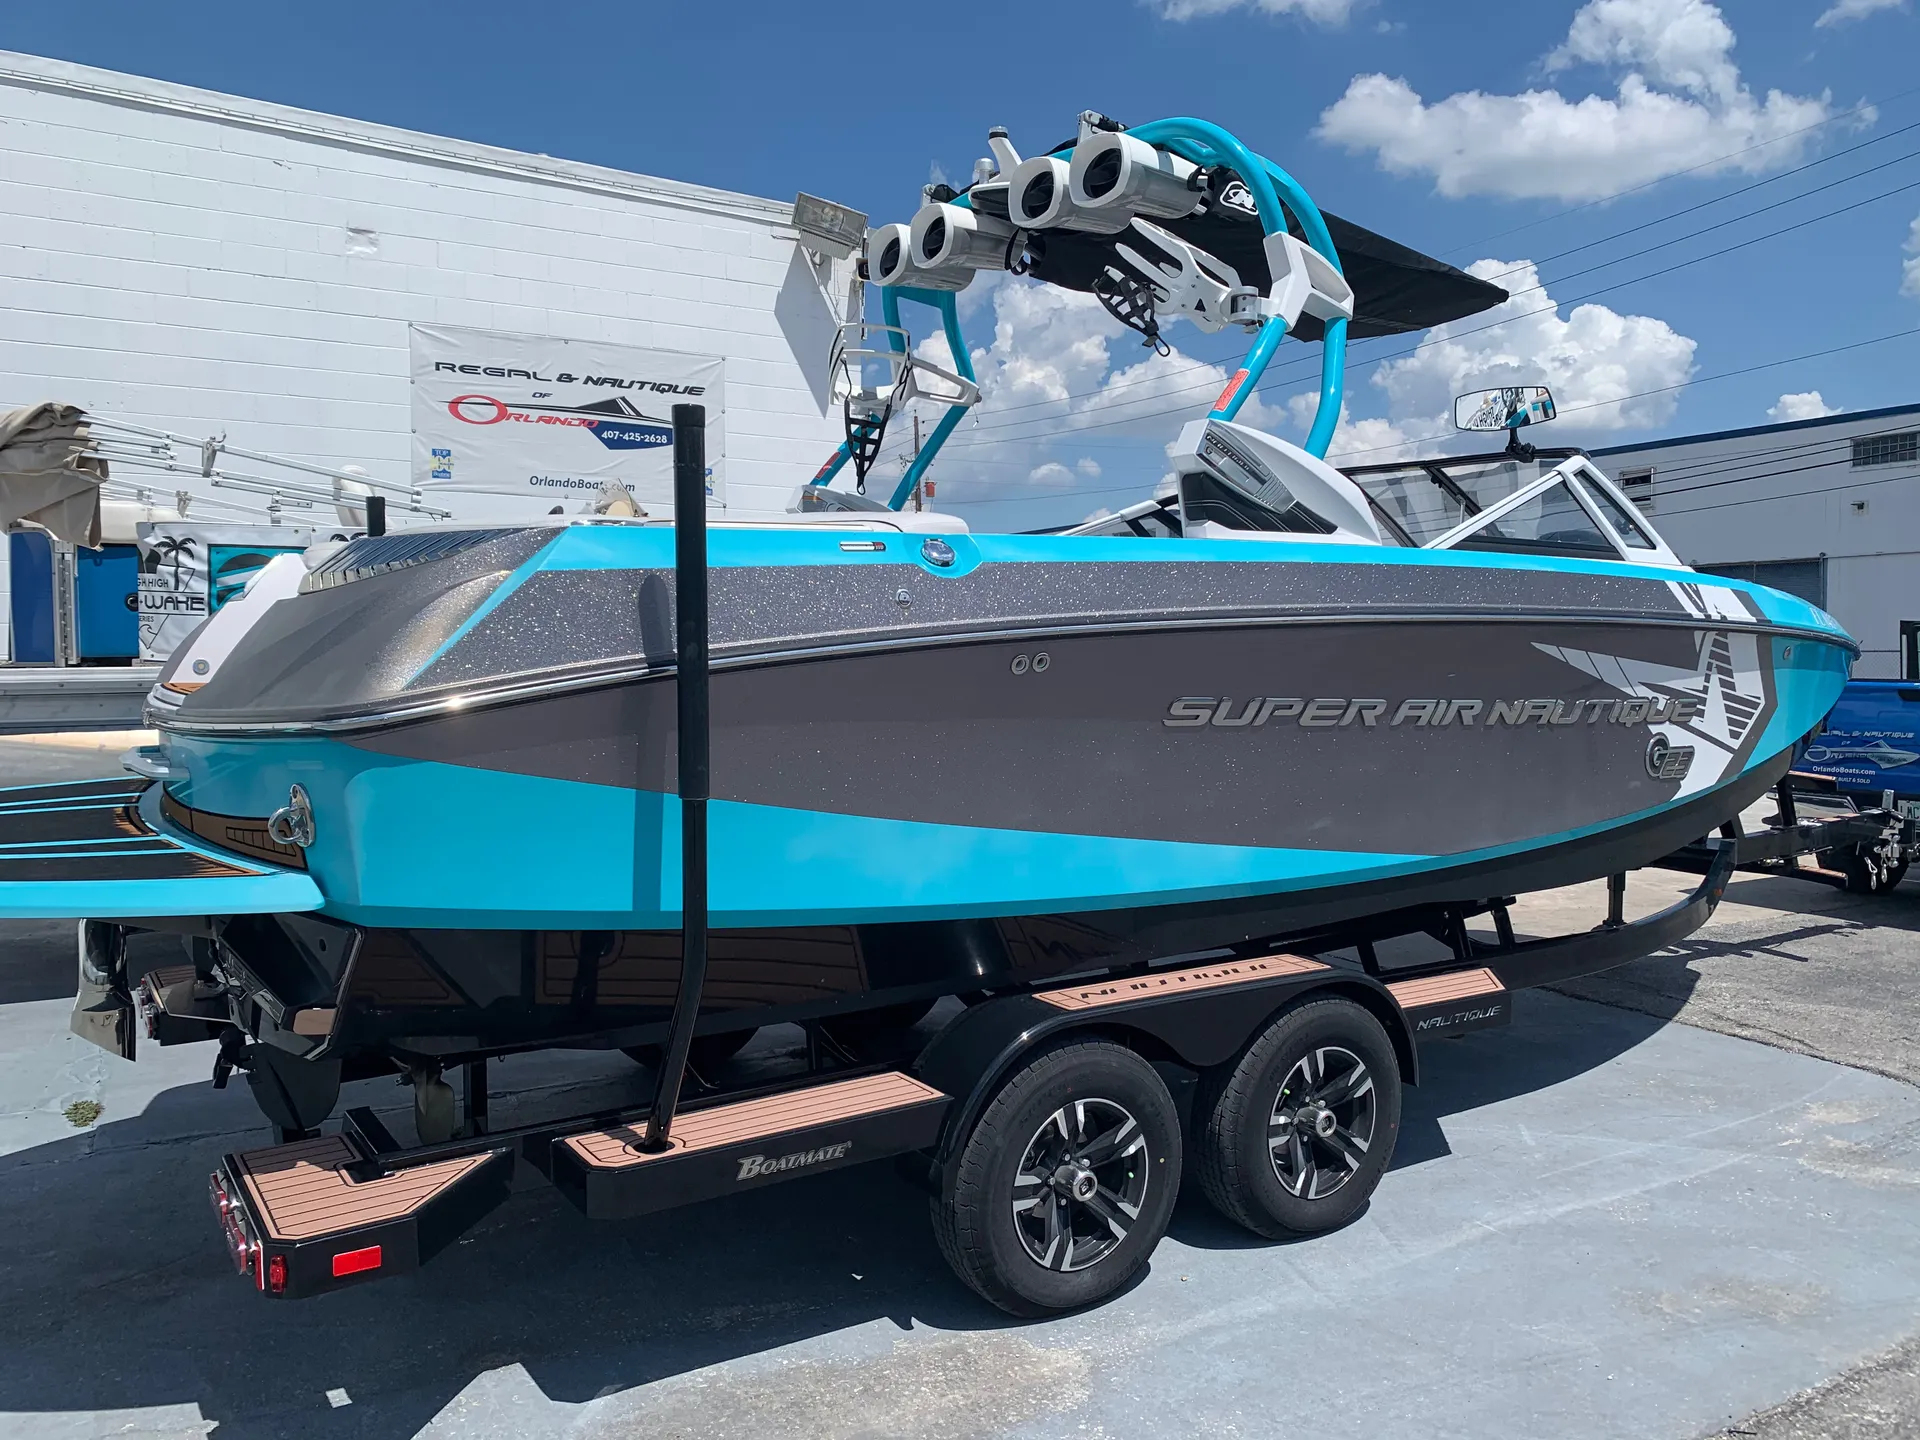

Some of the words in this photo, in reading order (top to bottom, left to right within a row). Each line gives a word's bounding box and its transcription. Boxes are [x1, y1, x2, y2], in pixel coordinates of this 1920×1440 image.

[434, 361, 552, 383] REGAL
[556, 373, 579, 384] &
[582, 374, 706, 396] NAUTIQUE
[448, 394, 599, 428] ORLANDO
[601, 430, 668, 443] 407-425-2628
[148, 578, 169, 588] HIGH
[1162, 696, 1387, 728] SUPER
[1390, 698, 1484, 727] AIR
[1484, 696, 1701, 728] NAUTIQUE
[1863, 731, 1915, 739] NAUTIQUE
[1812, 765, 1876, 776] OrlandoBoats.com
[1416, 1005, 1502, 1031] NAUTIQUE
